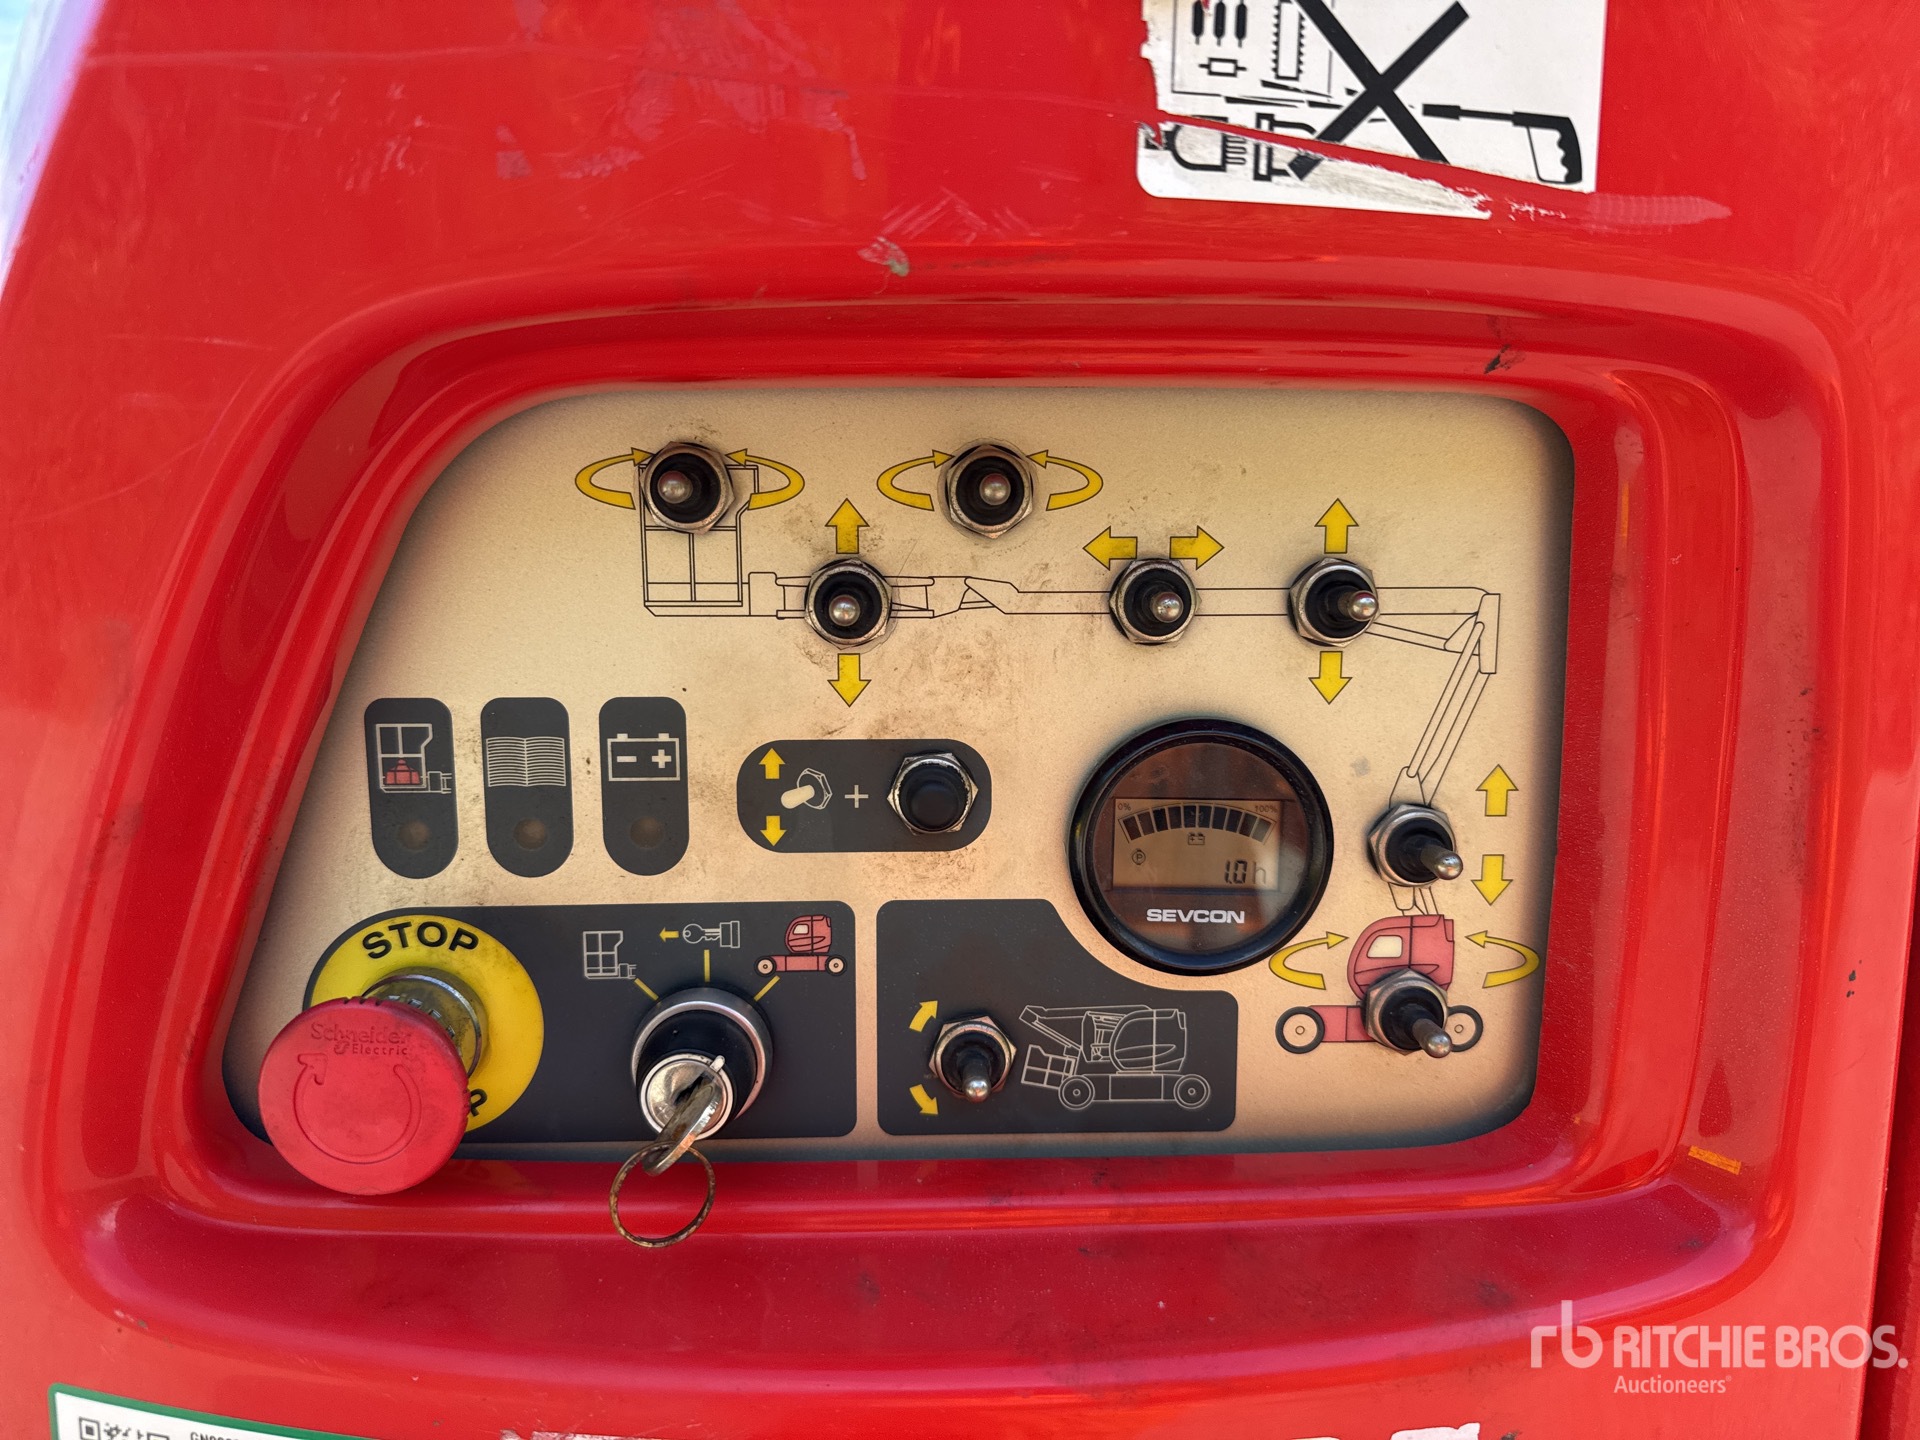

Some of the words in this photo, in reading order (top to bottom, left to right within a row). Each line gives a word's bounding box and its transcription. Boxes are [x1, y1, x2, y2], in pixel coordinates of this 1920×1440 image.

[1117, 803, 1132, 811] 0%
[1254, 805, 1279, 813] 100%
[1146, 908, 1246, 924] SEVCON
[362, 921, 480, 960] STOP
[310, 1022, 412, 1045] Schneider
[351, 1042, 409, 1056] Electric
